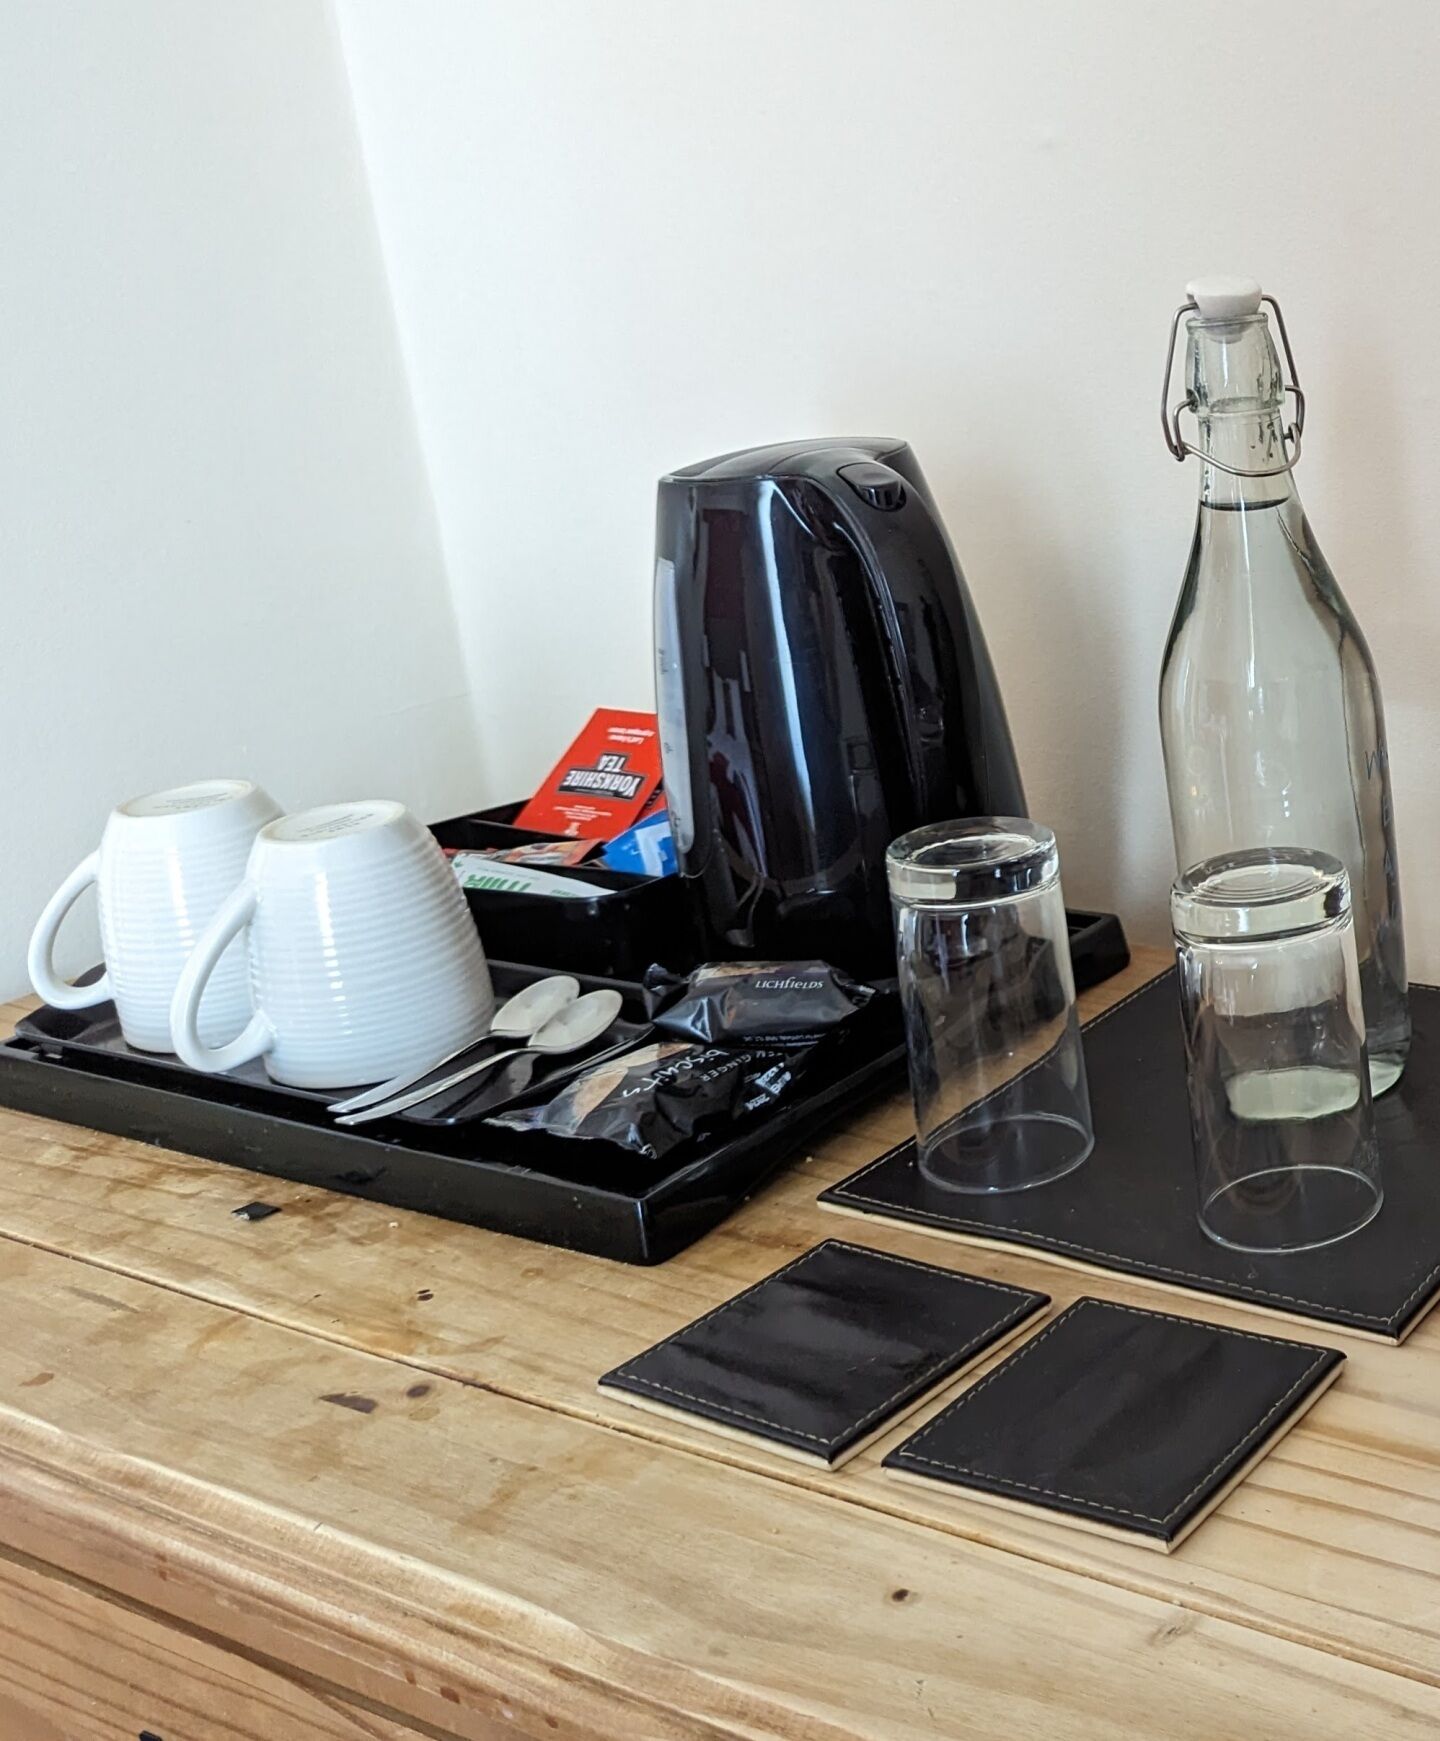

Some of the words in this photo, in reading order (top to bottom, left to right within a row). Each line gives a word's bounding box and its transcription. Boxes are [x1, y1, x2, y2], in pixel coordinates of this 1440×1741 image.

[597, 754, 626, 772] TEA
[563, 770, 641, 798] YORKSHIRE
[622, 1048, 730, 1098] biscuits
[700, 1054, 752, 1083] GINGER
